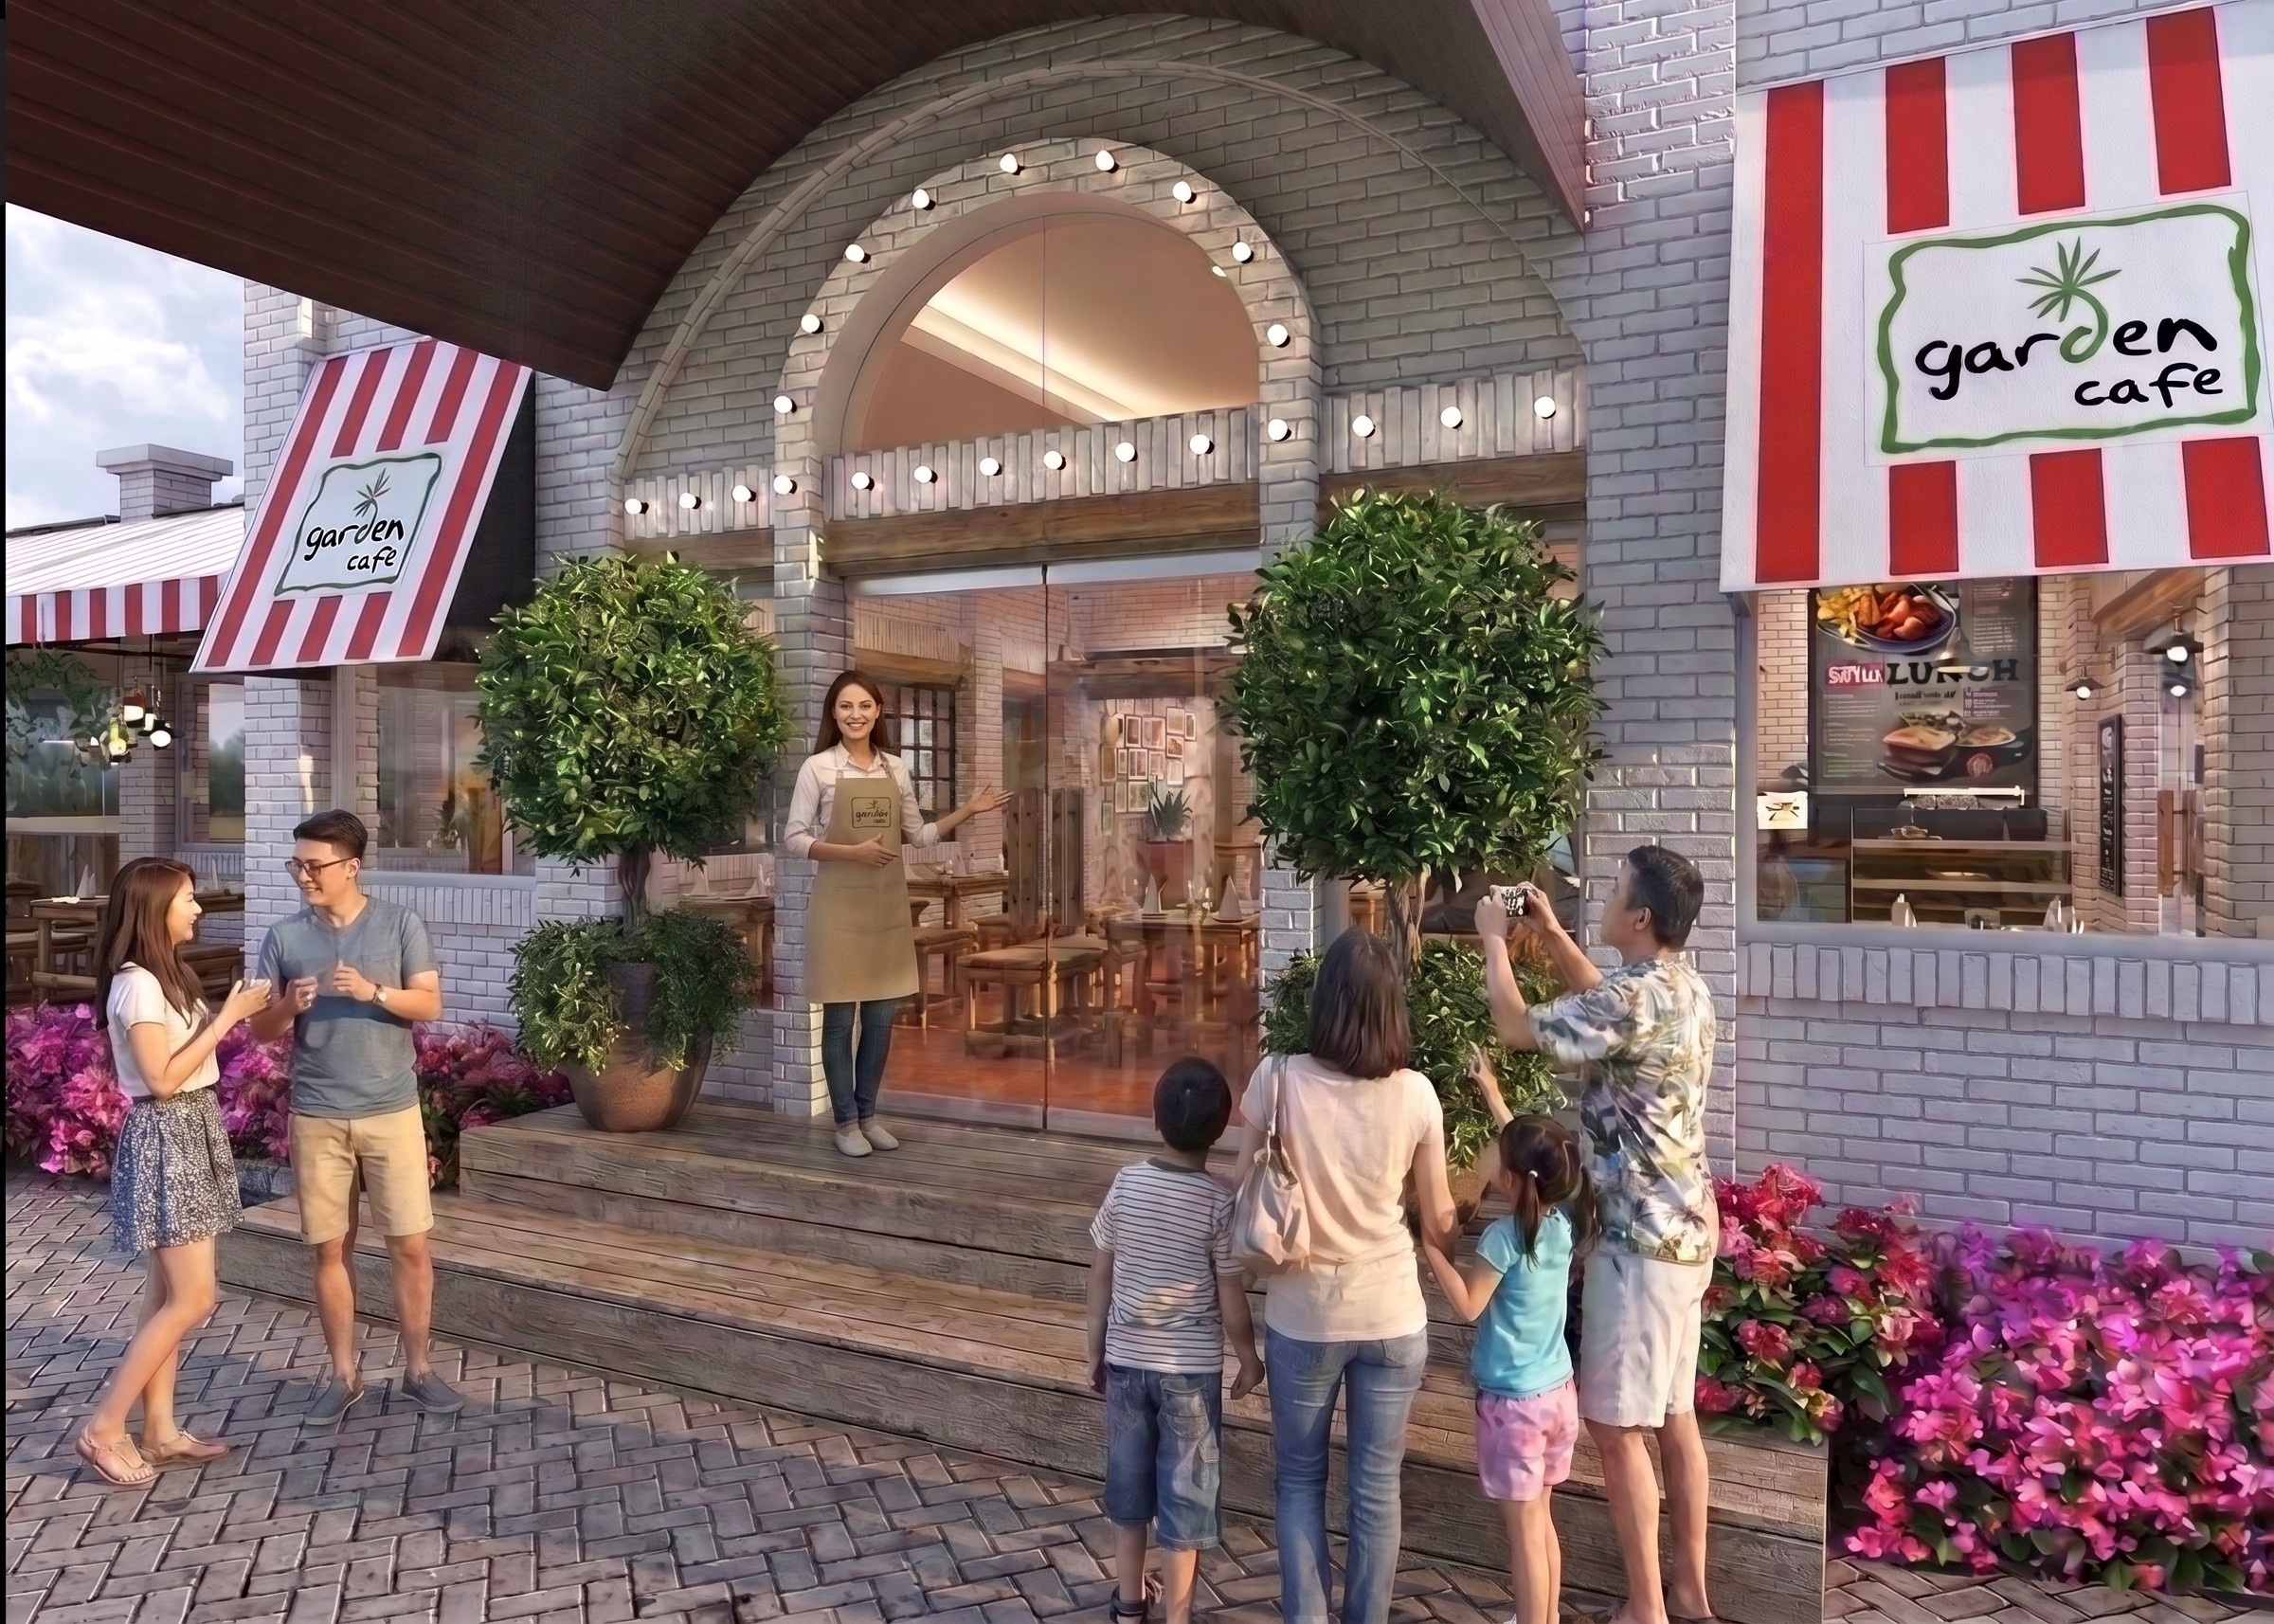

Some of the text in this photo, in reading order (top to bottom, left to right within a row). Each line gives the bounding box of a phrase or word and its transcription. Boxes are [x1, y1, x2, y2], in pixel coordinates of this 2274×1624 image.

[1915, 287, 2218, 401] garden
[2074, 362, 2224, 409] cafe
[304, 497, 405, 562] garden
[347, 546, 397, 574] cafe
